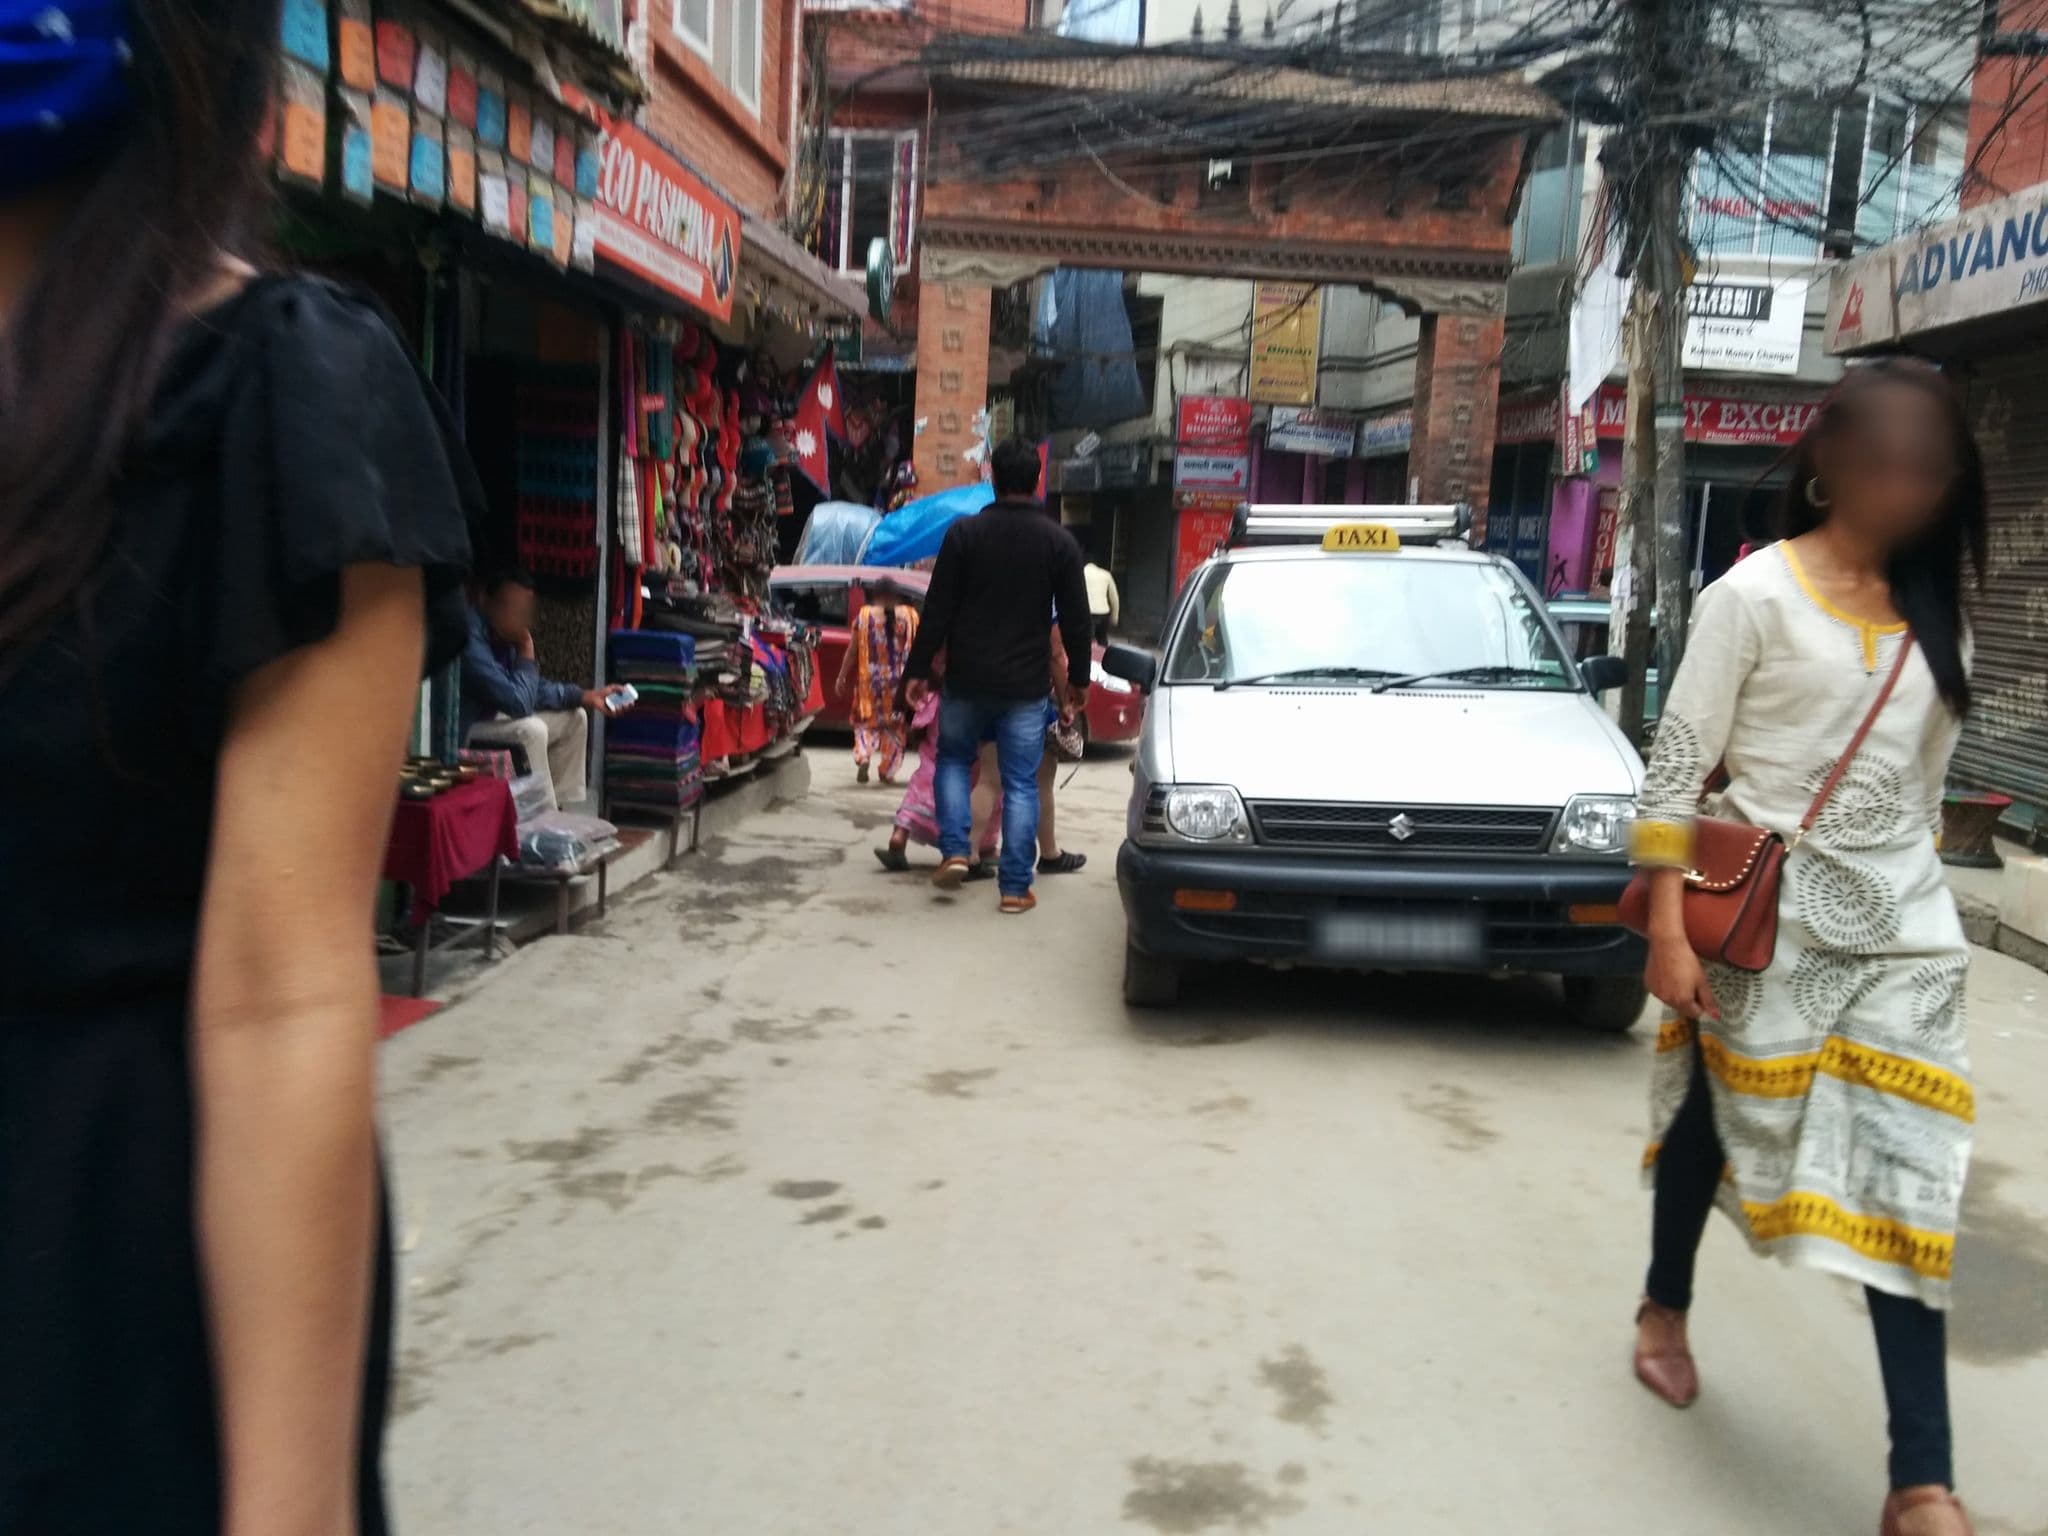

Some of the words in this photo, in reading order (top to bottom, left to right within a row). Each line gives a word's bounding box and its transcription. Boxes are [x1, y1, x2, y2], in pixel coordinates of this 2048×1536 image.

[633, 160, 716, 272] PASHMINA
[1724, 345, 1755, 361] Money
[1756, 347, 1795, 363] Changer
[1717, 401, 1819, 433] EXCHA
[1334, 528, 1388, 546] TAXI
